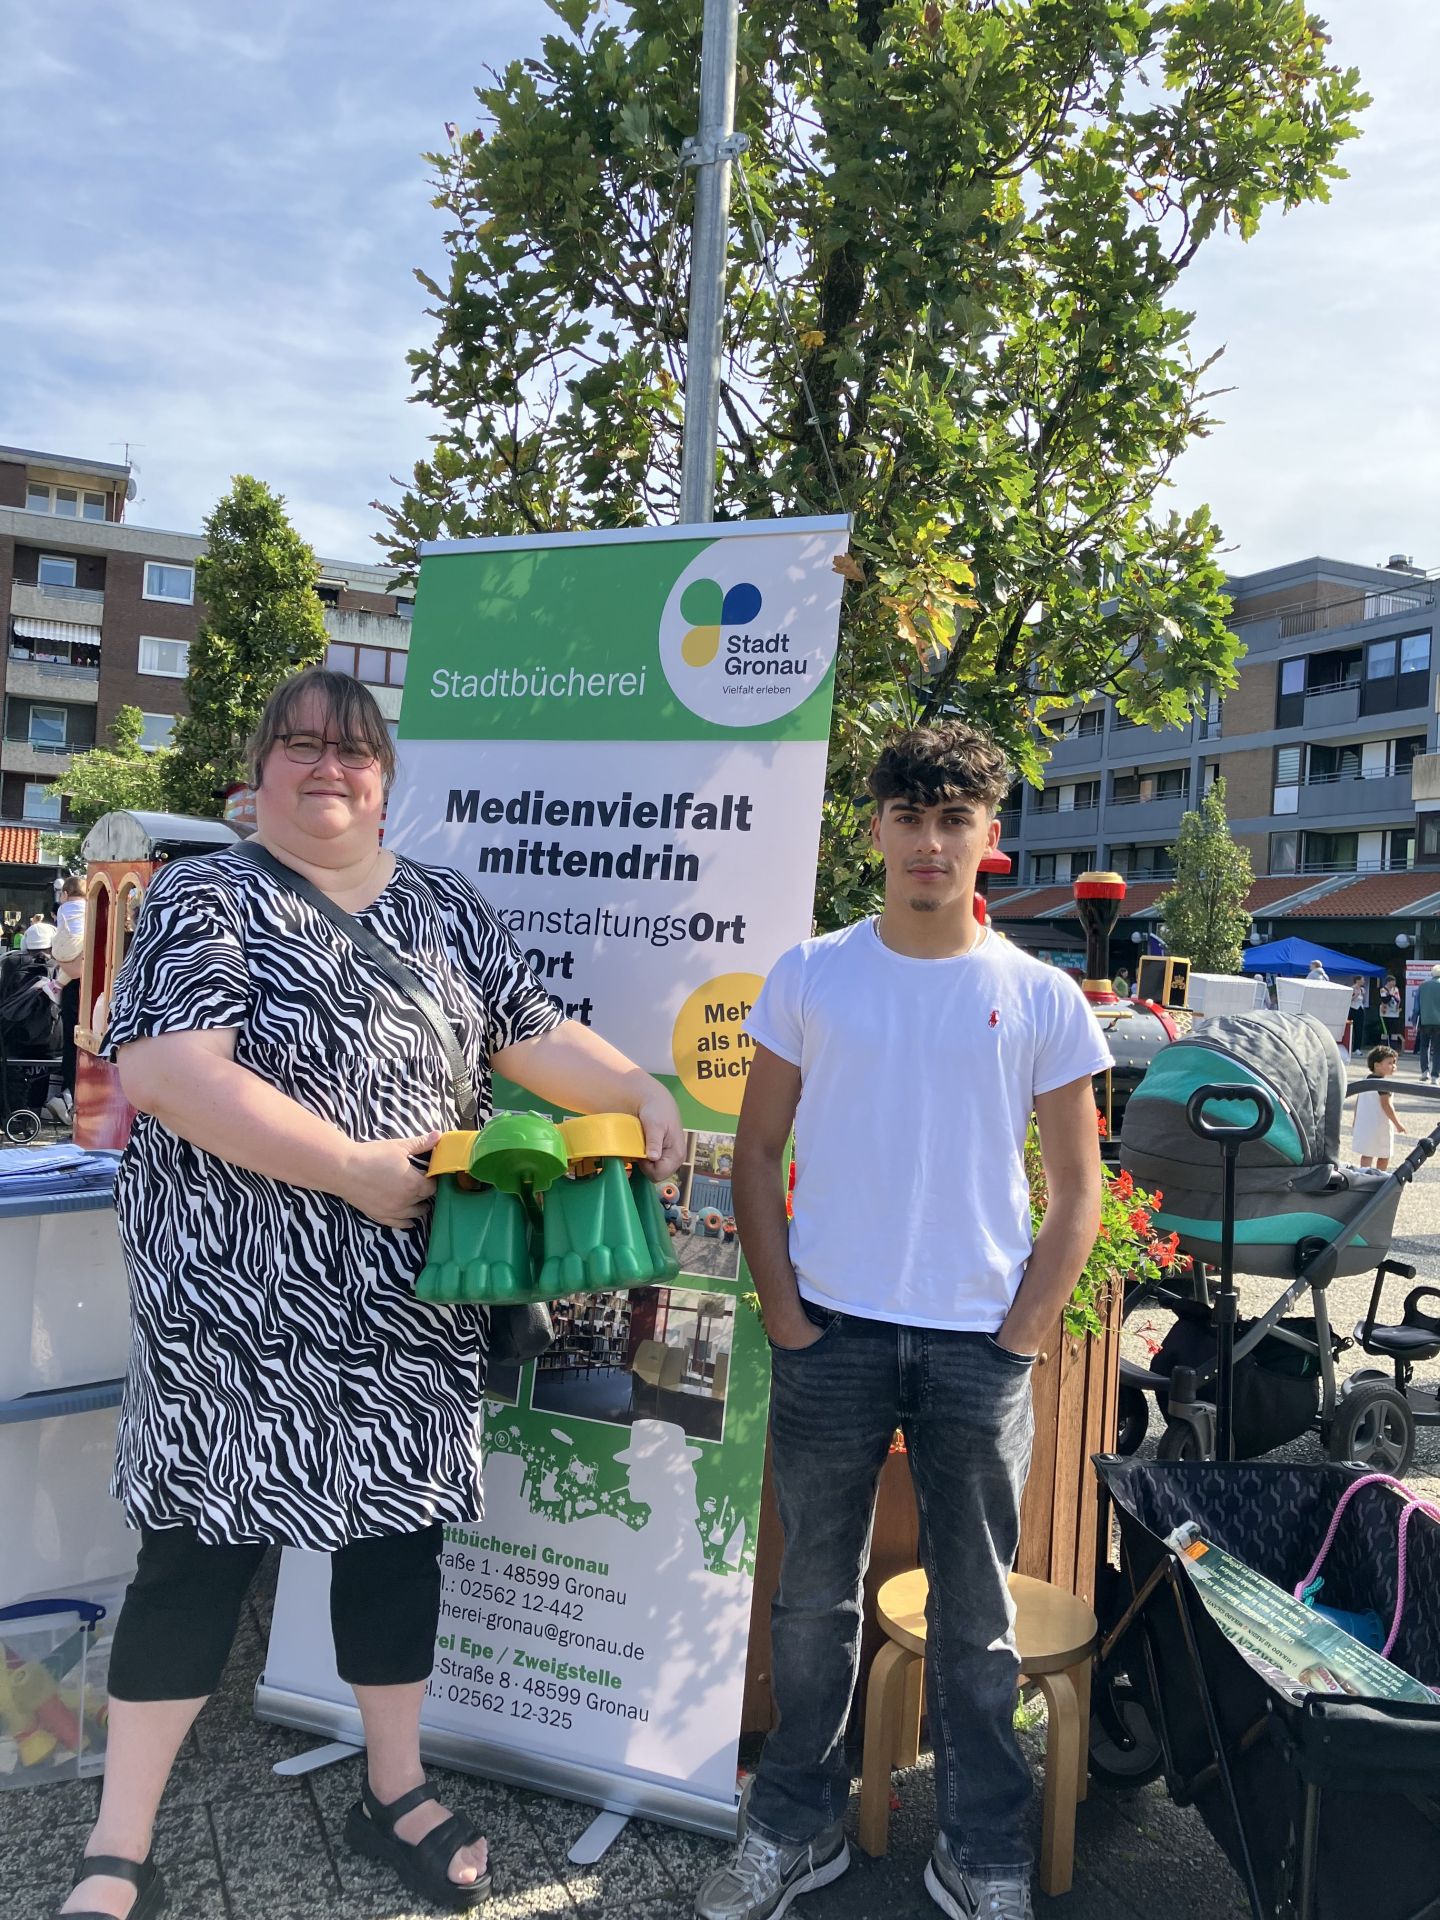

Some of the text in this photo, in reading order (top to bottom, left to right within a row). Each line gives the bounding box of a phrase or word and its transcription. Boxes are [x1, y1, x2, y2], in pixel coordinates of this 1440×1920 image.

[727, 634, 789, 654] Stadt
[430, 666, 646, 698] Stadtbücherei
[724, 656, 807, 676] Gronau
[722, 685, 791, 695] Vielfalt erleben
[445, 789, 753, 832] Medienvielfalt
[477, 839, 700, 882] mittendrin
[498, 907, 746, 946] ranstaltungsOrt
[524, 948, 574, 979] Ort
[704, 1001, 752, 1024] Meh
[697, 1032, 730, 1052] als
[697, 1057, 753, 1079] Büch
[442, 1526, 609, 1576] dtbücherei Gronau
[440, 1553, 627, 1605] raße 1 48599 Gronau
[441, 1575, 584, 1621] l.: 02562 12-442
[439, 1600, 644, 1660] herei-gronau@gronau.de
[460, 1637, 494, 1659] Epe
[512, 1649, 622, 1689] Zweigstelle
[435, 1658, 649, 1722] -Straße 8 48599 Gronau
[448, 1685, 504, 1713] 02562
[510, 1700, 572, 1729] 12-325
